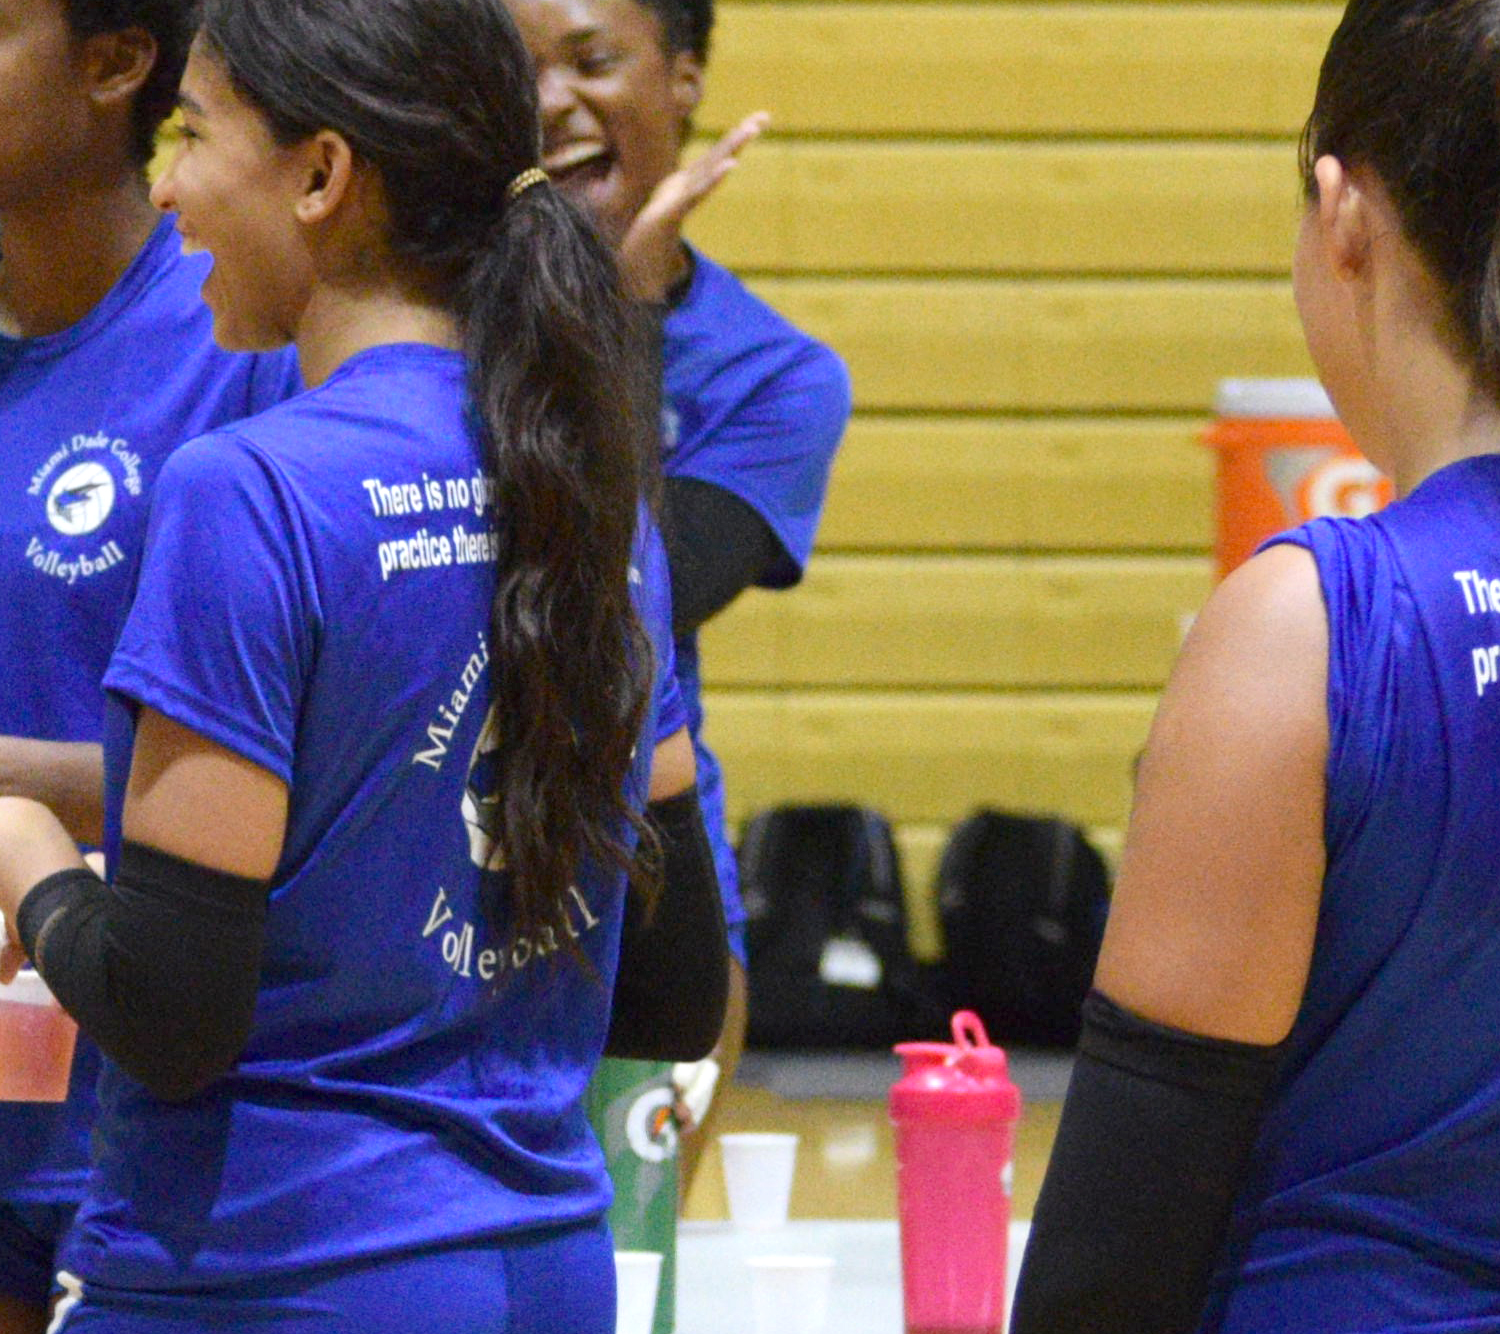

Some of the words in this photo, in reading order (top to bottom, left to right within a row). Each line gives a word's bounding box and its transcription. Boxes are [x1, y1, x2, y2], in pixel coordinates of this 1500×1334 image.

[362, 478, 423, 516] There
[422, 472, 444, 511] is
[445, 478, 469, 509] no
[25, 536, 125, 585] Volleyball
[378, 527, 453, 582] practice
[452, 524, 490, 564] there
[412, 630, 490, 772] Miami
